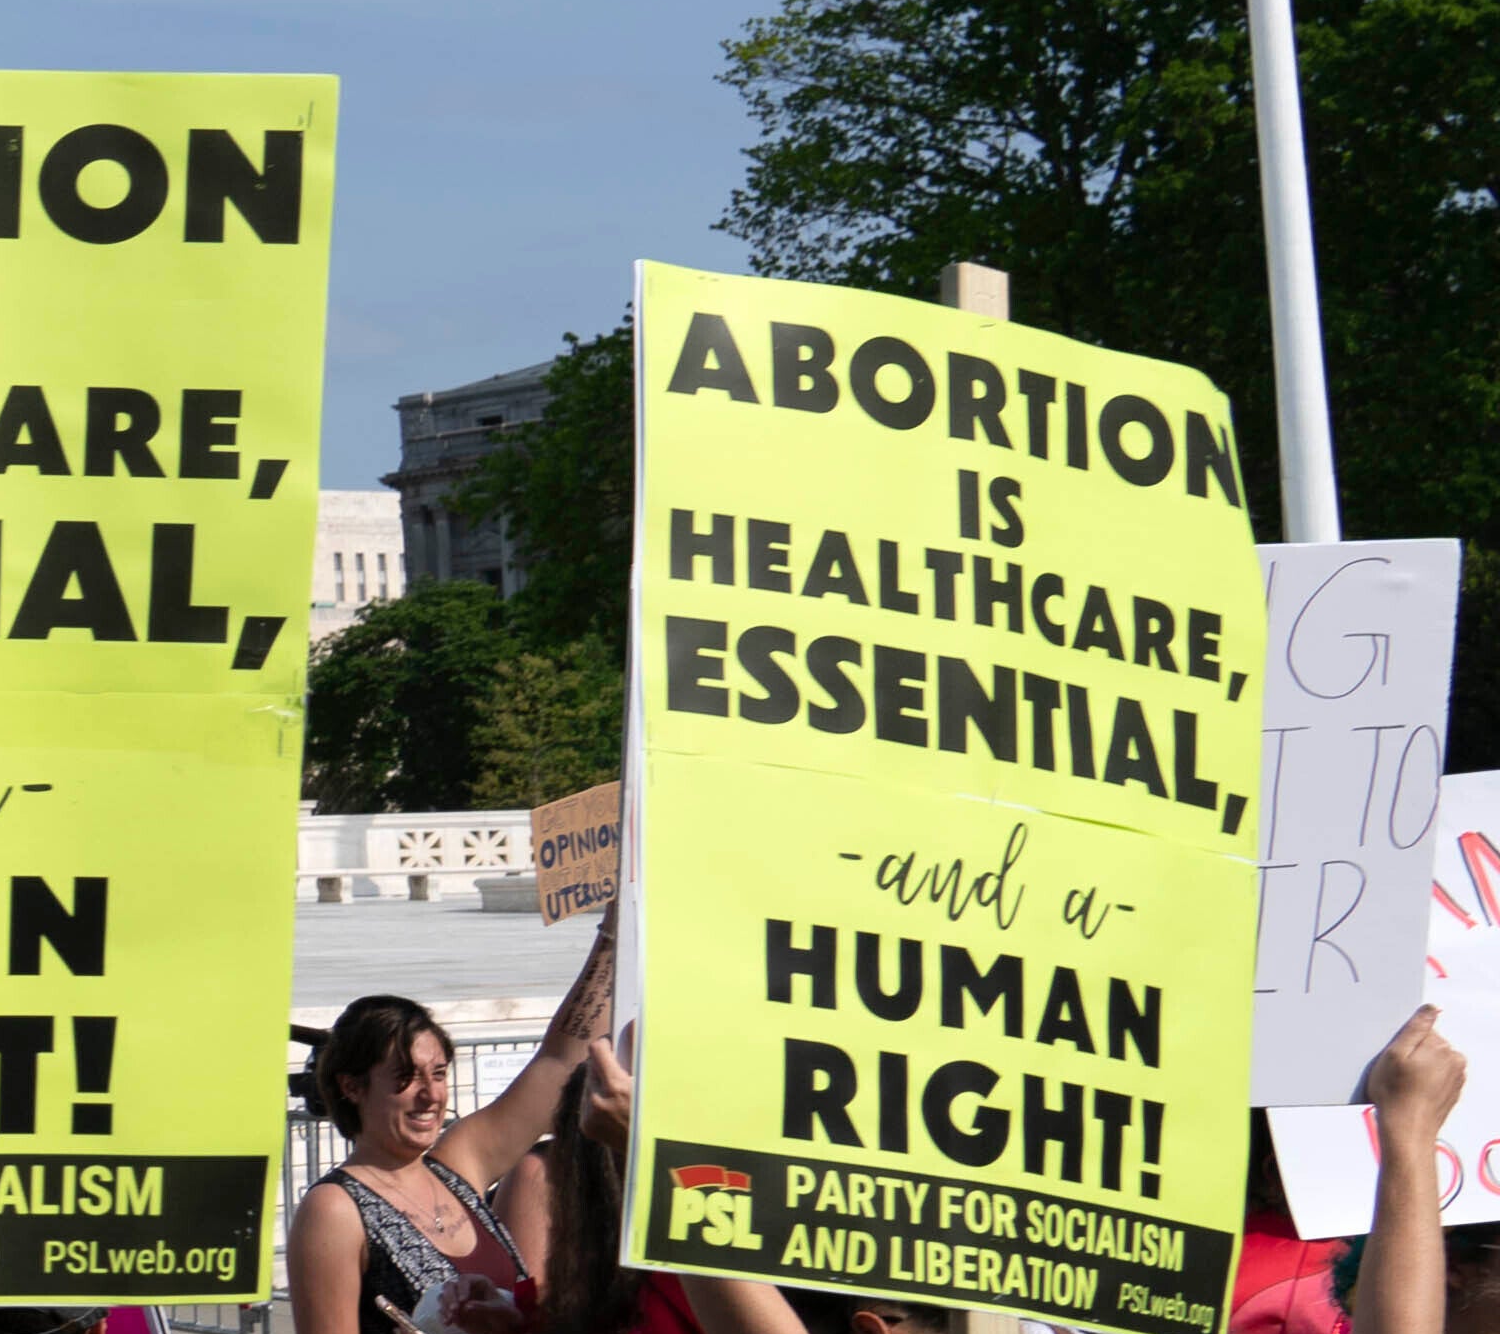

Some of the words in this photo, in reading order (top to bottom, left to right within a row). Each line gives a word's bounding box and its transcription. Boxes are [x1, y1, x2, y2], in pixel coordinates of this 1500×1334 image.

[667, 312, 1241, 508] ABORTION
[958, 469, 1023, 548] IS
[670, 508, 1248, 701] HEALTHCARE,
[666, 615, 1248, 834] ESSENTIAL,
[1352, 725, 1441, 849] TO
[546, 878, 616, 920] UTERUS
[766, 919, 1162, 1068] HUMAN
[782, 1038, 1166, 1200] RIGHT!
[43, 1239, 237, 1280] PSLweb.org
[670, 1187, 762, 1252] PSL
[780, 1222, 876, 1277] AND
[889, 1236, 1099, 1312] LIBERATION
[1117, 1282, 1216, 1334] PSLweb.org
[786, 1165, 927, 1226] PARTY
[939, 1187, 1018, 1241] FOR
[1026, 1199, 1185, 1273] SOCIALISM
